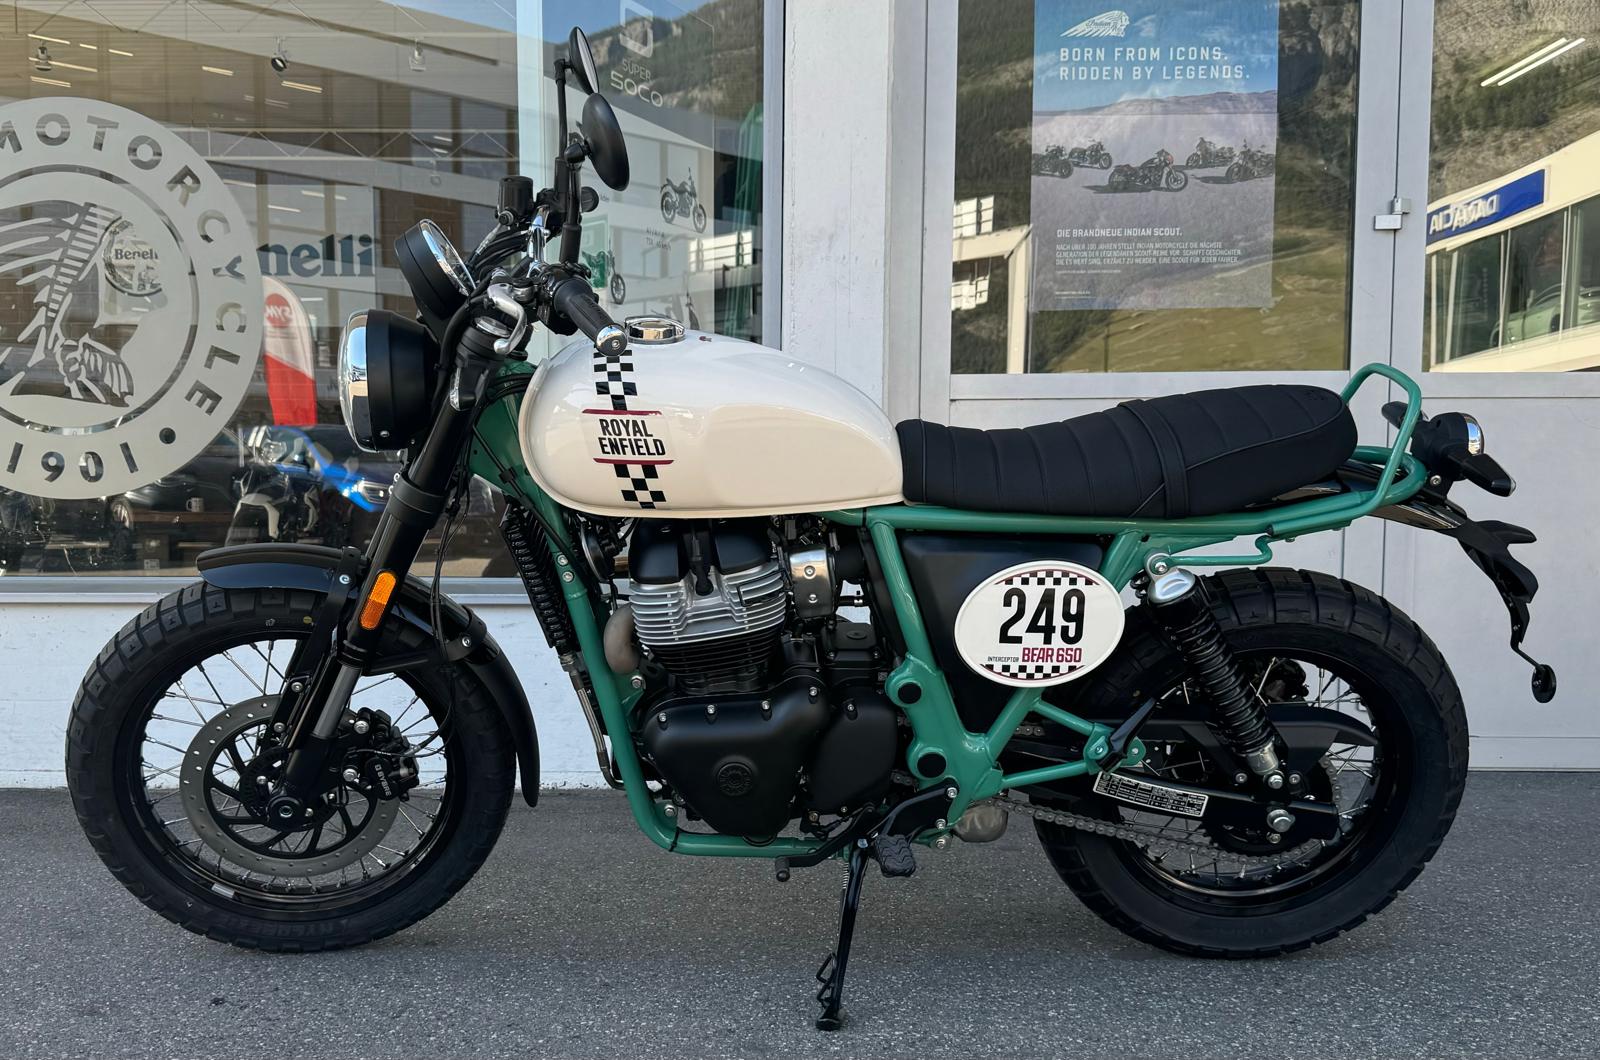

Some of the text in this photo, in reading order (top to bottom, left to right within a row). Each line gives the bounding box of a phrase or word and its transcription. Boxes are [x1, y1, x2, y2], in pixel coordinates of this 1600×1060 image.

[1060, 46, 1228, 62] BORN FROM ICONS.
[622, 58, 651, 81] SUPER
[1060, 66, 1123, 81] RIDDEN
[1133, 66, 1152, 80] BY
[610, 69, 663, 108] SOCO
[1056, 227, 1183, 238] DIE BRANDNEUE INDIAN SCOUT.
[256, 234, 375, 277] nelli
[599, 418, 654, 437] ROYAL
[598, 437, 666, 456] ENFIELD
[6, 441, 139, 483] 1901
[999, 587, 1086, 645] 249
[1021, 647, 1055, 663] BEAR
[1056, 647, 1083, 663] 650
[377, 770, 392, 797] BYBRE
